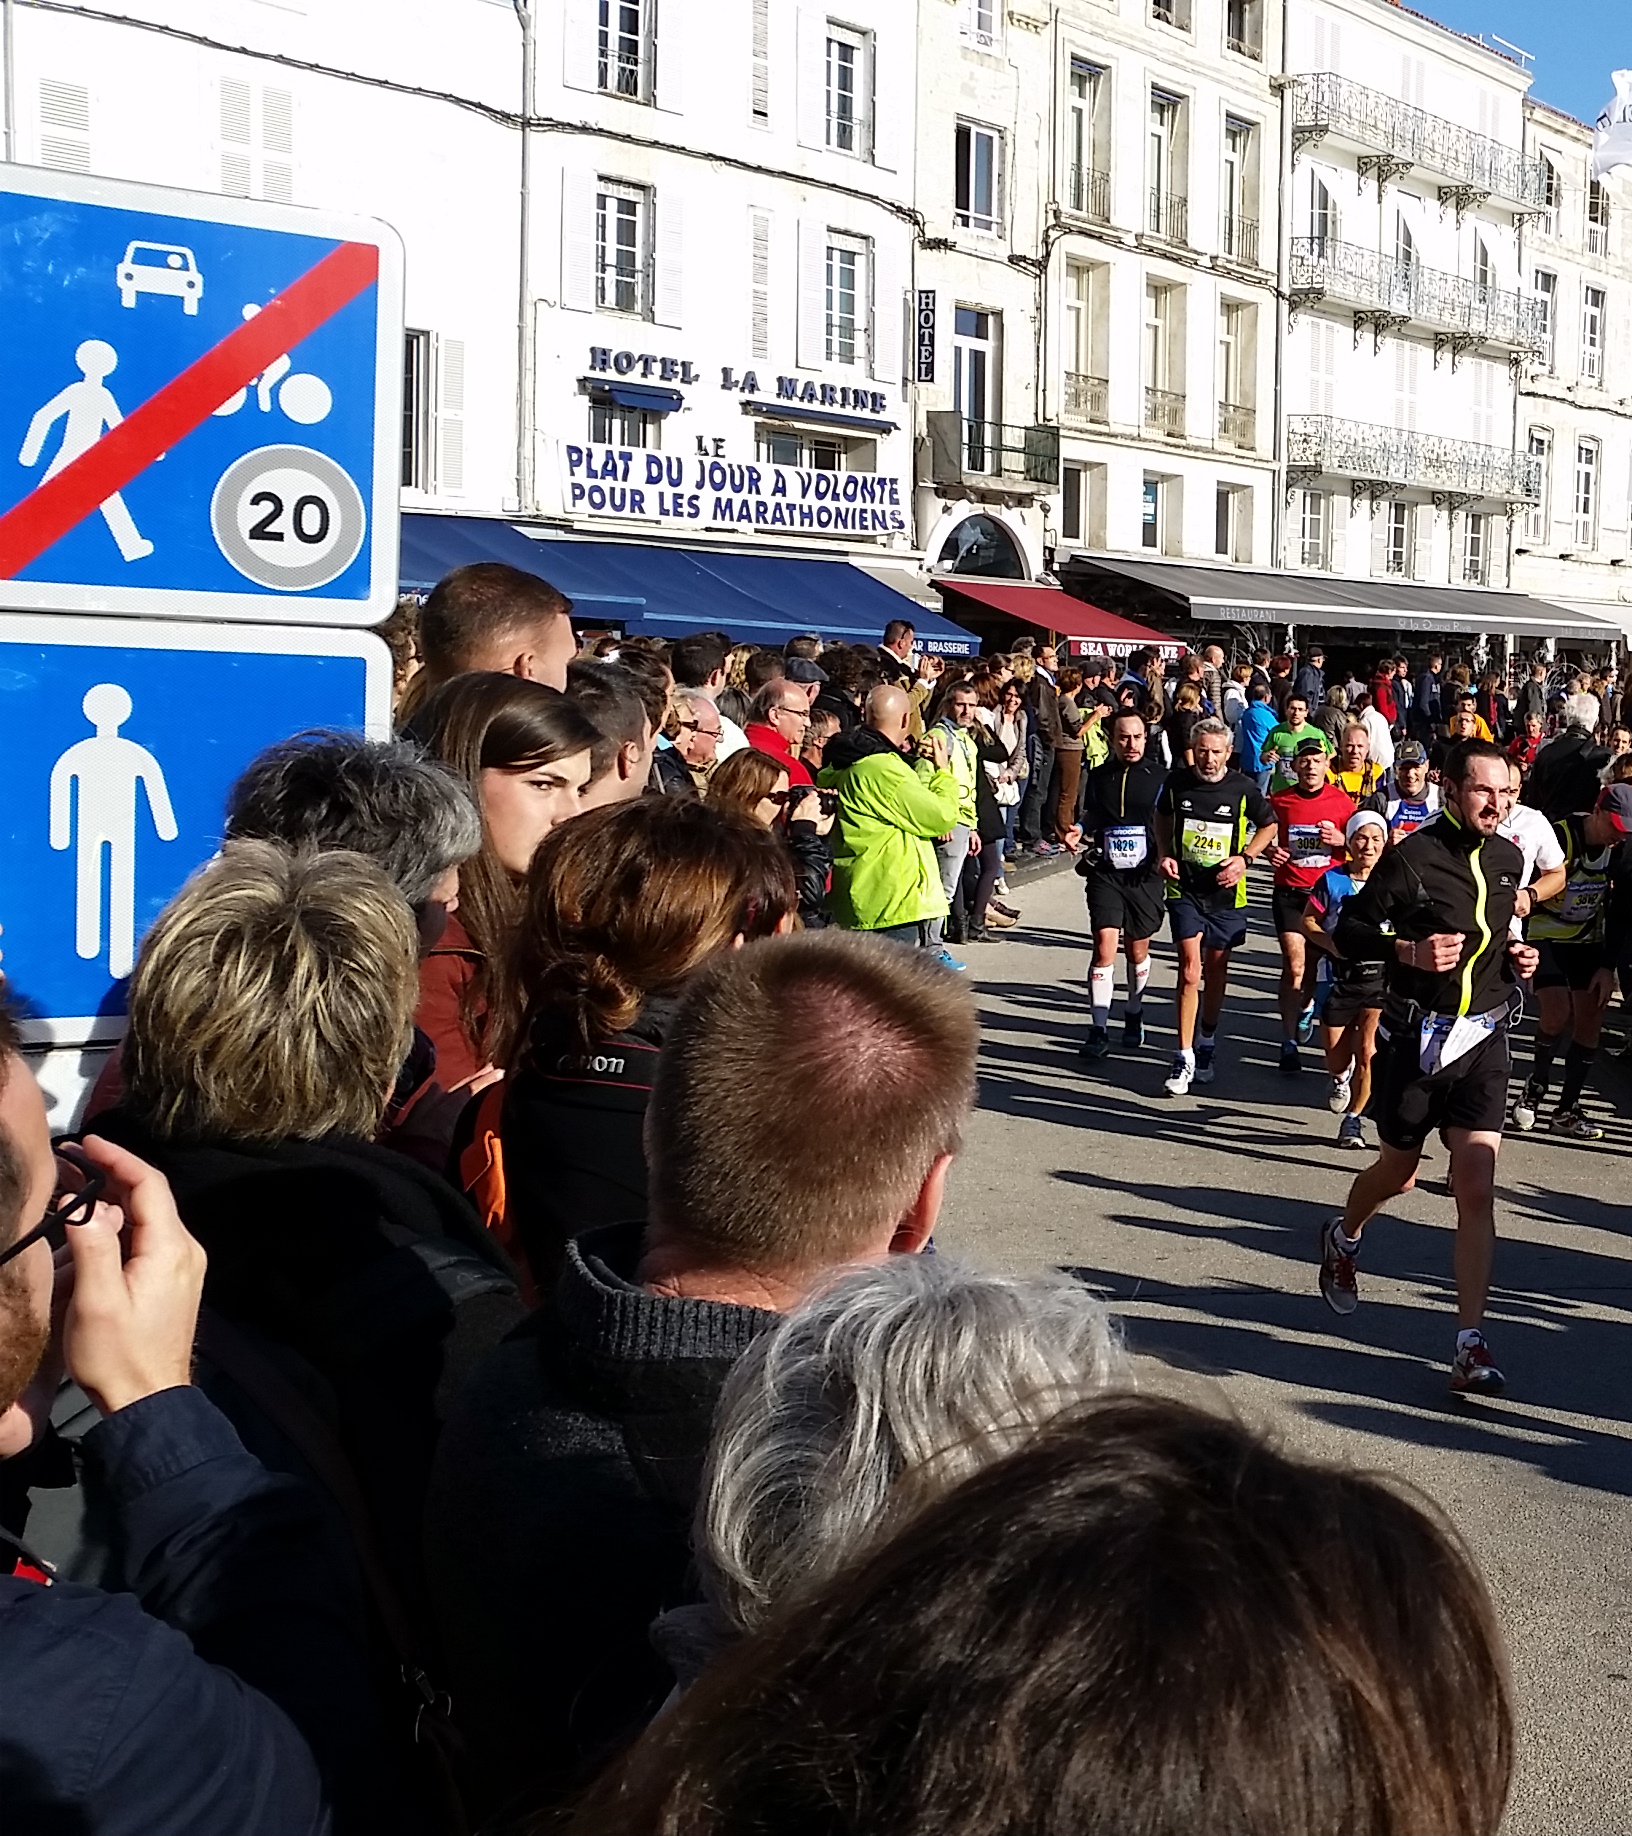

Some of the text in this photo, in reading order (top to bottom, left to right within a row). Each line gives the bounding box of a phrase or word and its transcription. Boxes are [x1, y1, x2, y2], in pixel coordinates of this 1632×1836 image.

[919, 293, 935, 381] HOTEL
[590, 346, 888, 413] HOTEL LA MARINE
[695, 435, 726, 458] LE
[565, 445, 633, 483] PLAT
[645, 455, 683, 487] DU
[695, 460, 762, 496] JOUR
[796, 470, 901, 506] VOLONTE
[570, 482, 905, 531] POUR LES MARATHONIENS
[249, 491, 330, 545] 20
[1220, 607, 1277, 622] RESTAURANT
[912, 640, 970, 655] AR BRASSERIE
[1080, 641, 1103, 656] SEA
[1112, 839, 1135, 852] 1828
[1194, 835, 1214, 850] 224
[1297, 837, 1322, 850] 3092
